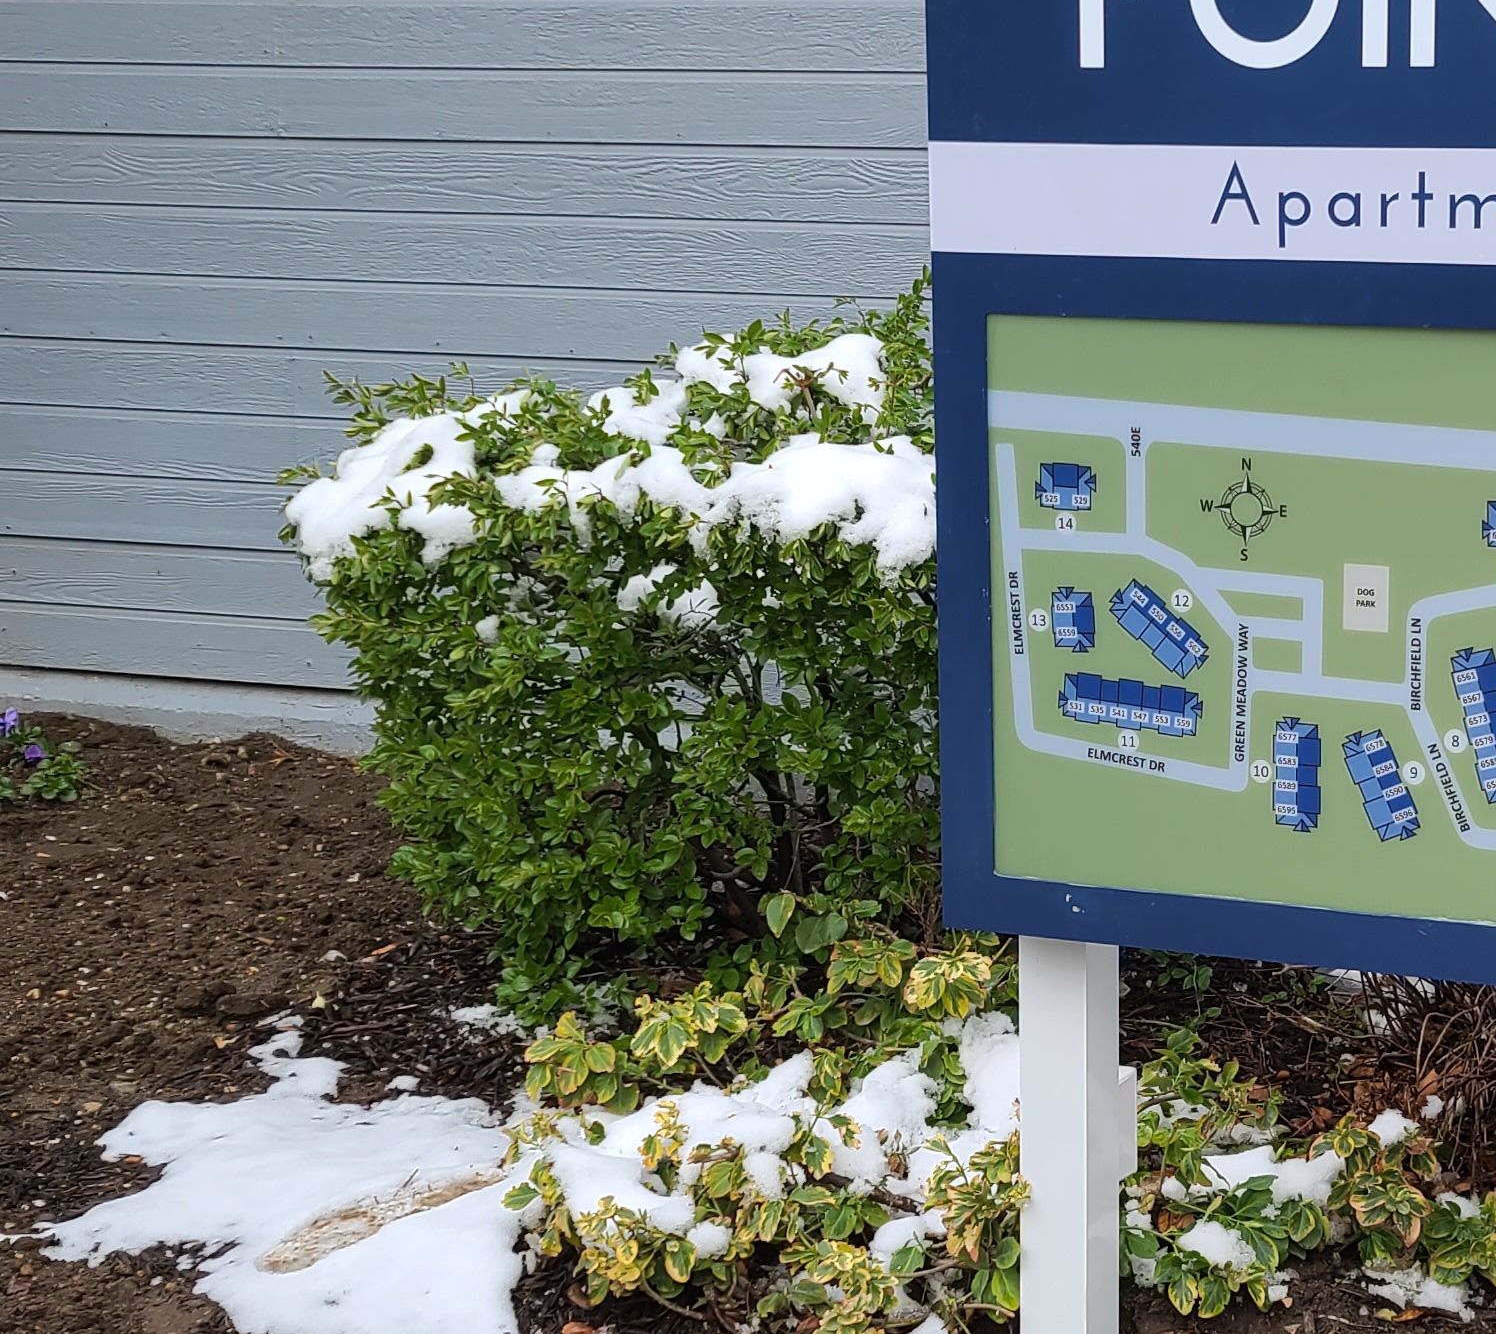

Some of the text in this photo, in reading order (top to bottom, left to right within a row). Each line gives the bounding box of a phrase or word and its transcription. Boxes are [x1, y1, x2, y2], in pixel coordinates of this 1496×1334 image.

[1131, 427, 1141, 457] 540E
[1242, 459, 1251, 471] N
[1044, 494, 1088, 505] 525 529
[1200, 500, 1213, 511] W
[1280, 505, 1287, 517] E
[1059, 518, 1073, 529] 14
[1240, 549, 1248, 561] S
[1357, 588, 1375, 596] DOG
[1174, 596, 1189, 606] 12
[1356, 600, 1375, 608] PARK
[1009, 571, 1024, 654] ELMCREST DR
[1056, 603, 1074, 611] 6553
[1032, 615, 1046, 626] 13
[1133, 591, 1200, 654] 544 550 556 562
[1411, 618, 1421, 710] BIRCHFIELD LN
[1457, 672, 1476, 682] 6561
[1235, 623, 1249, 762] GREEN MEADOW WAY
[1463, 693, 1481, 703] 6567
[1070, 702, 1082, 710] 531
[1091, 706, 1104, 714] 535
[1112, 709, 1125, 717] 541
[1155, 716, 1168, 724] 553
[1177, 719, 1190, 727] 559
[1469, 715, 1488, 725] 6573
[1121, 736, 1136, 747] 11
[1366, 741, 1384, 751] 6578
[1452, 735, 1459, 747] 8
[1475, 736, 1493, 746] 6579
[1087, 748, 1166, 772] ELMCREST DR
[1253, 766, 1268, 777] 10
[1375, 764, 1393, 775] 6584
[1410, 768, 1418, 778] 9
[1385, 787, 1403, 798] 6590
[1428, 743, 1470, 832] BIRCHFIELD LN
[1395, 810, 1413, 821] 6596
